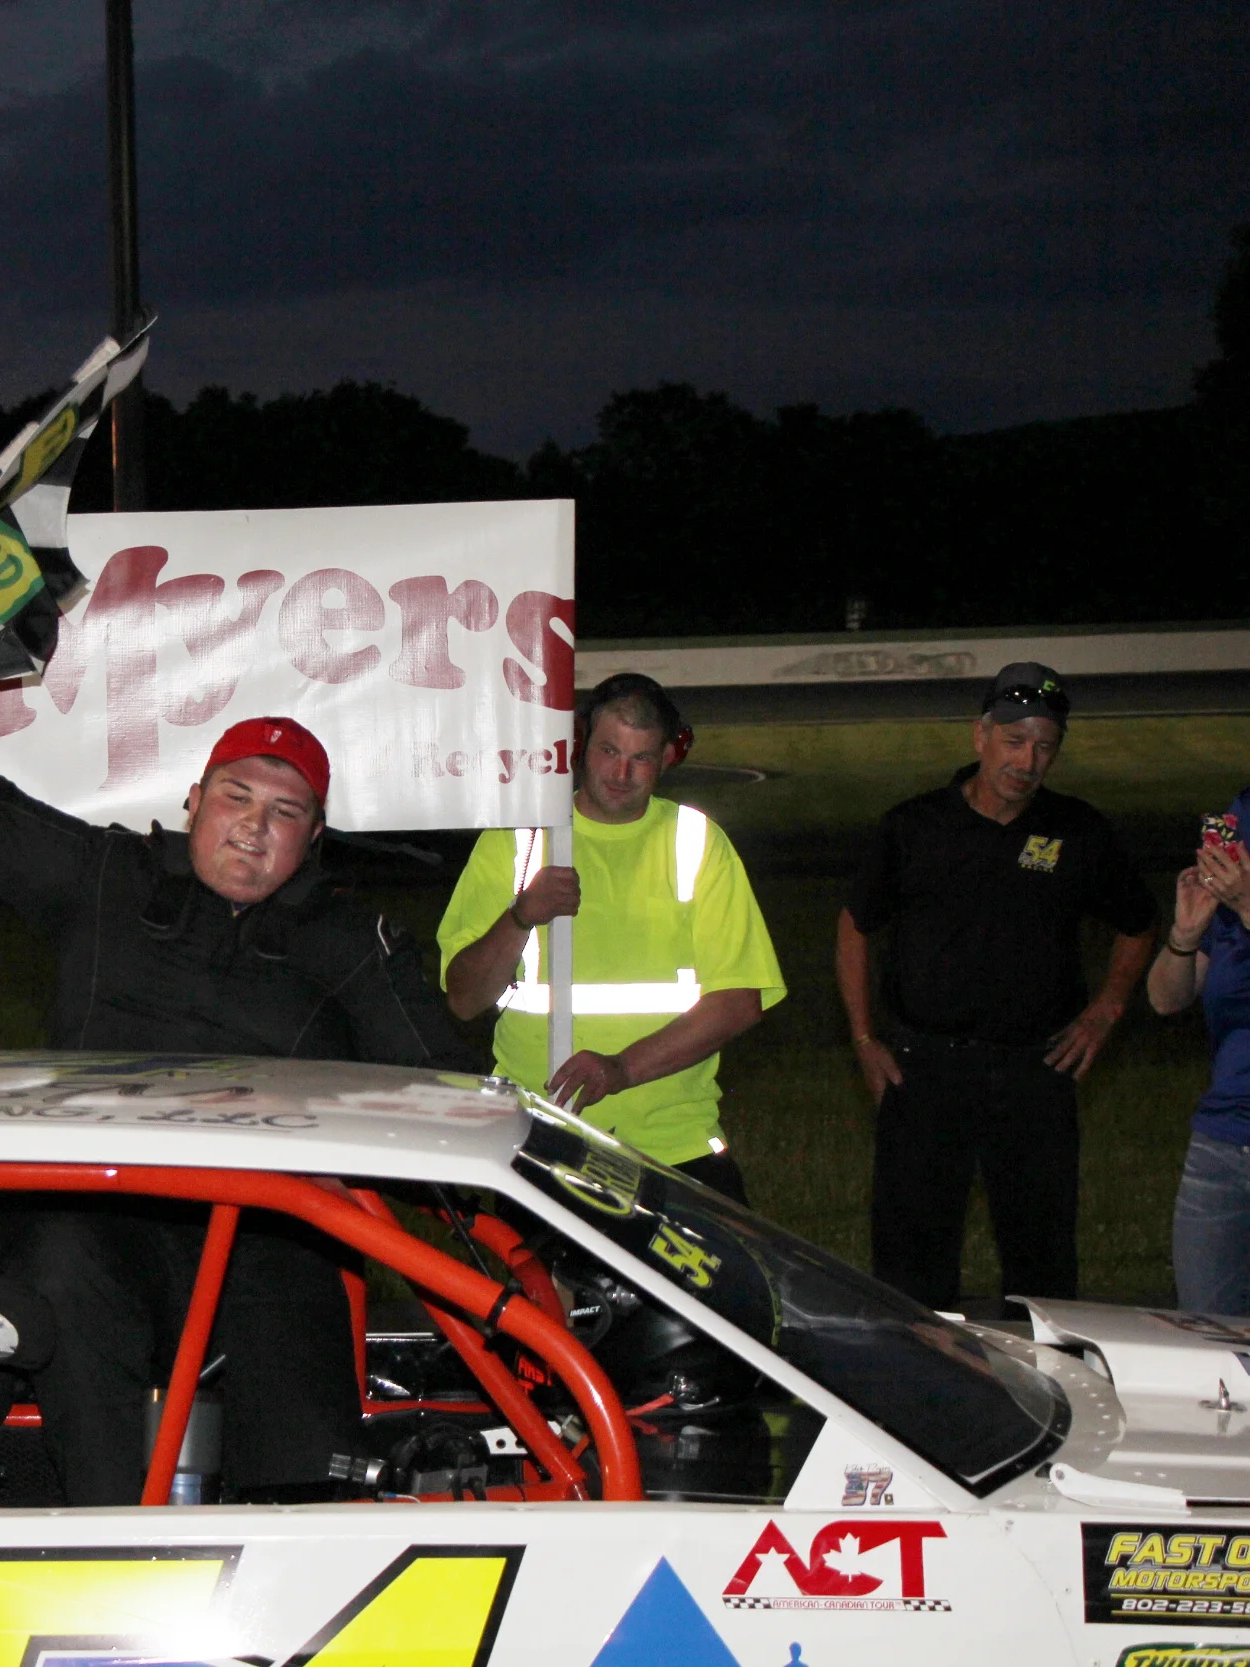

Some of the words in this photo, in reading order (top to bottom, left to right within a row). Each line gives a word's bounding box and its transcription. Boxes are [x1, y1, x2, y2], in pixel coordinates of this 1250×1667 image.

[1023, 835, 1064, 866] 54
[569, 1305, 601, 1318] IMPACT
[722, 1519, 948, 1598] ACT
[1105, 1532, 1226, 1567] FAST
[1108, 1567, 1250, 1593] MOTORSPO
[870, 1601, 895, 1610] TOUR
